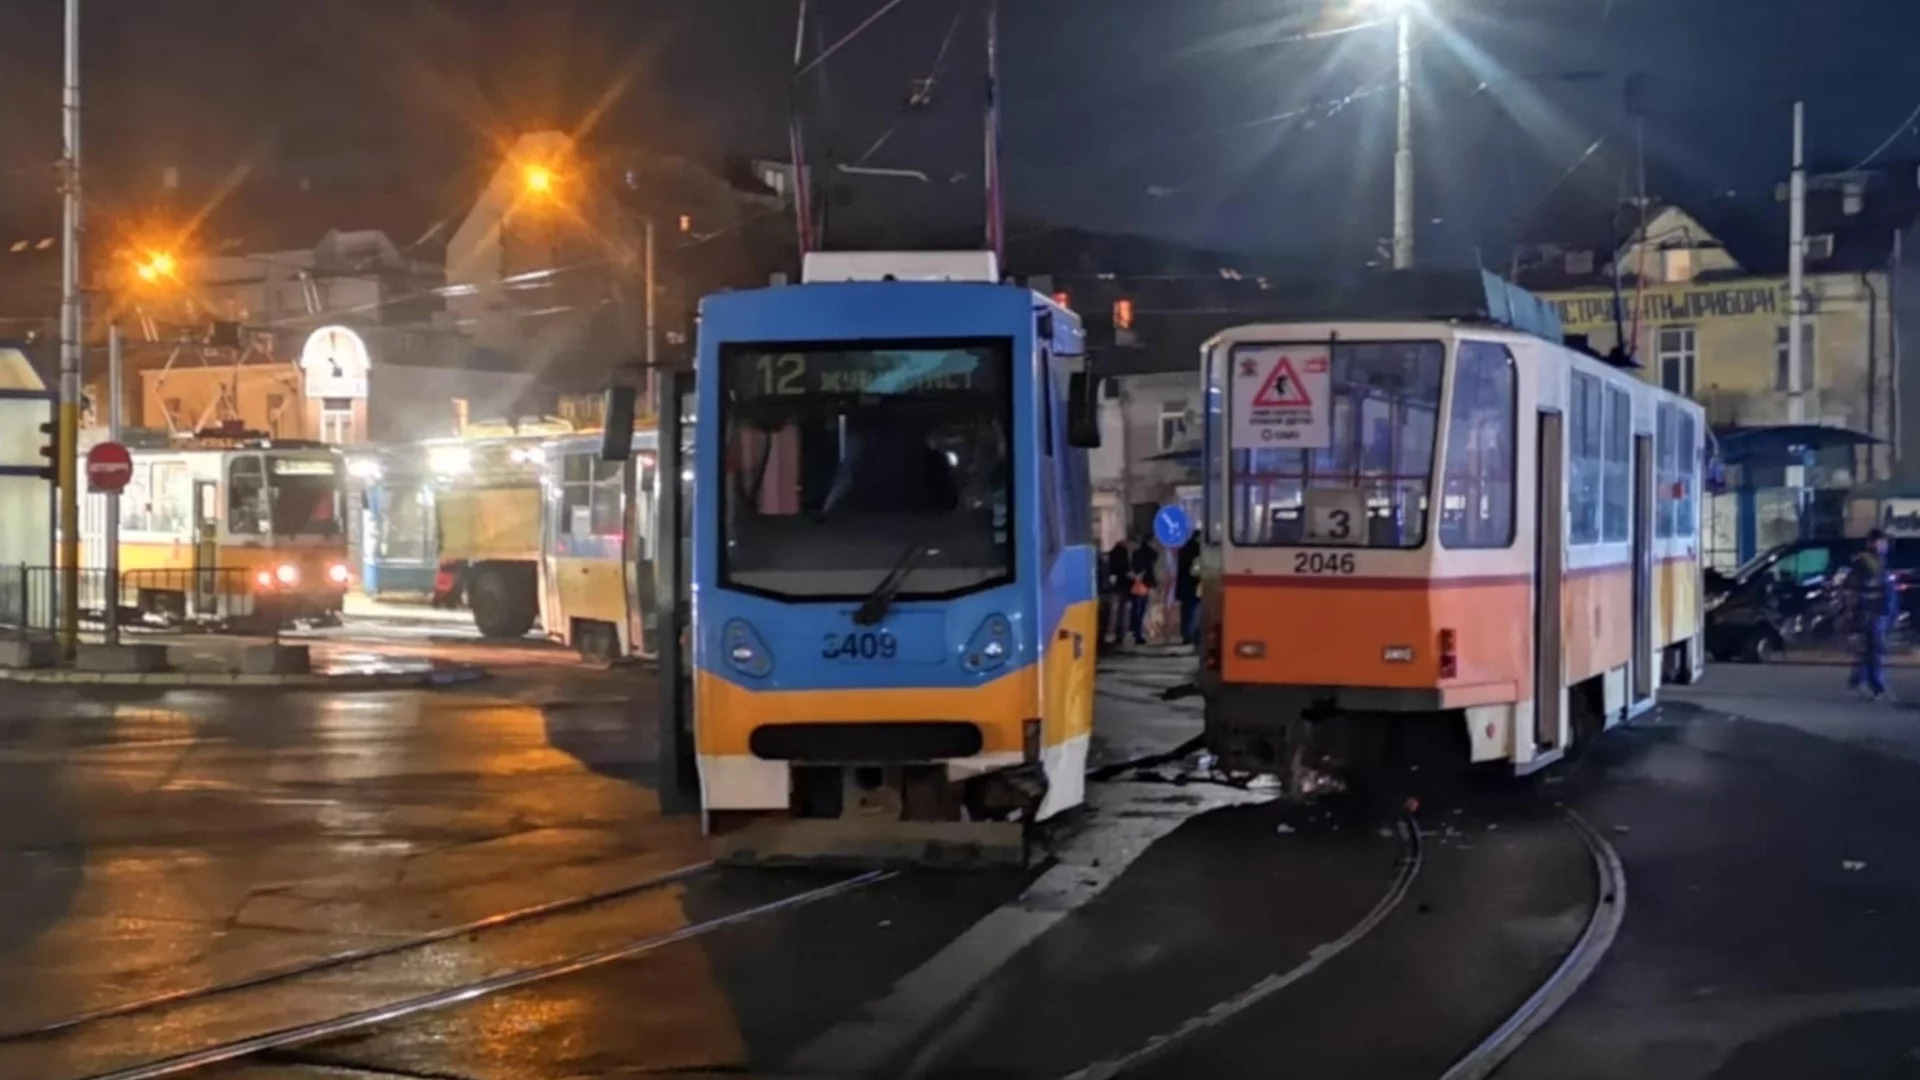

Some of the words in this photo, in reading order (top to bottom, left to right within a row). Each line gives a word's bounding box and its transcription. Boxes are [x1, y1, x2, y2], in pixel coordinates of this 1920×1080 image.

[756, 353, 805, 394] 12
[1328, 509, 1351, 539] 3
[1294, 552, 1355, 574] 2046
[821, 633, 897, 660] 3409
